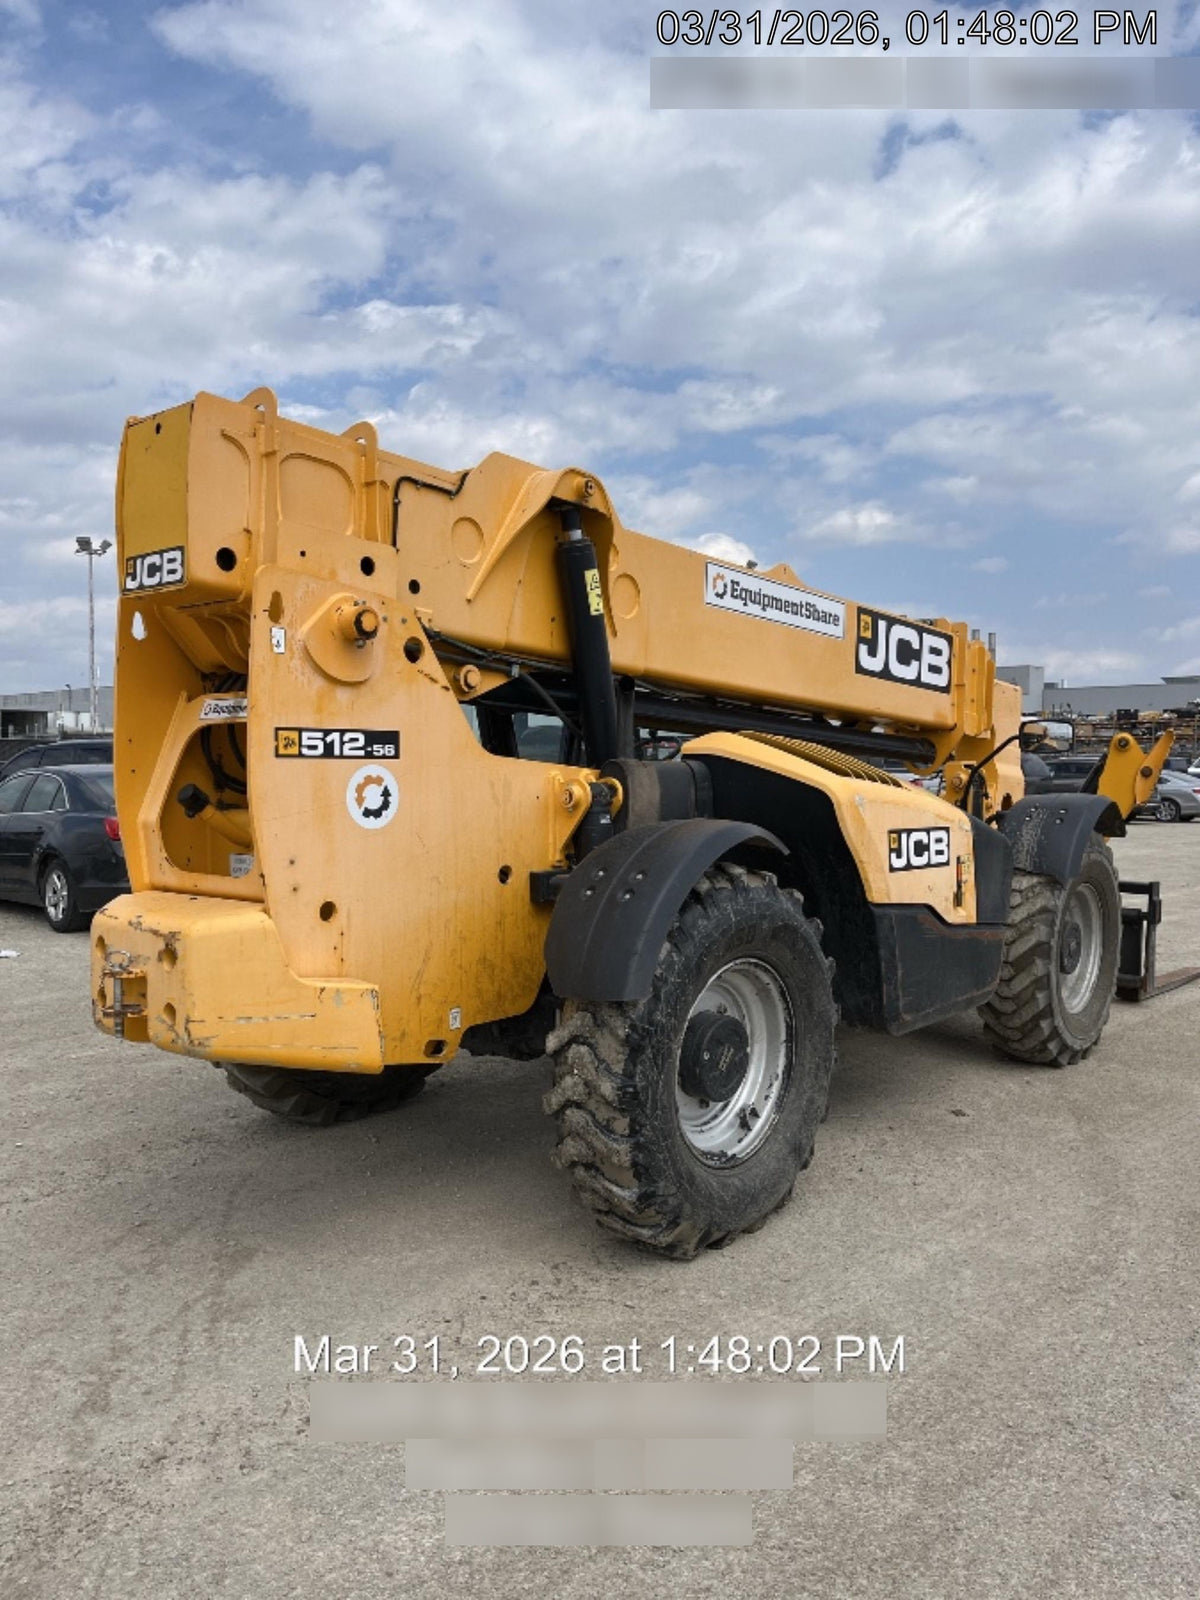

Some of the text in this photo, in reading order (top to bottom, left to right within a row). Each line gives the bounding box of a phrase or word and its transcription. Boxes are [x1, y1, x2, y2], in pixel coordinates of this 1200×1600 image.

[125, 549, 184, 590] JCB
[729, 578, 841, 627] EquipmentShare
[858, 618, 951, 688] JCB
[889, 829, 950, 869] JCB
